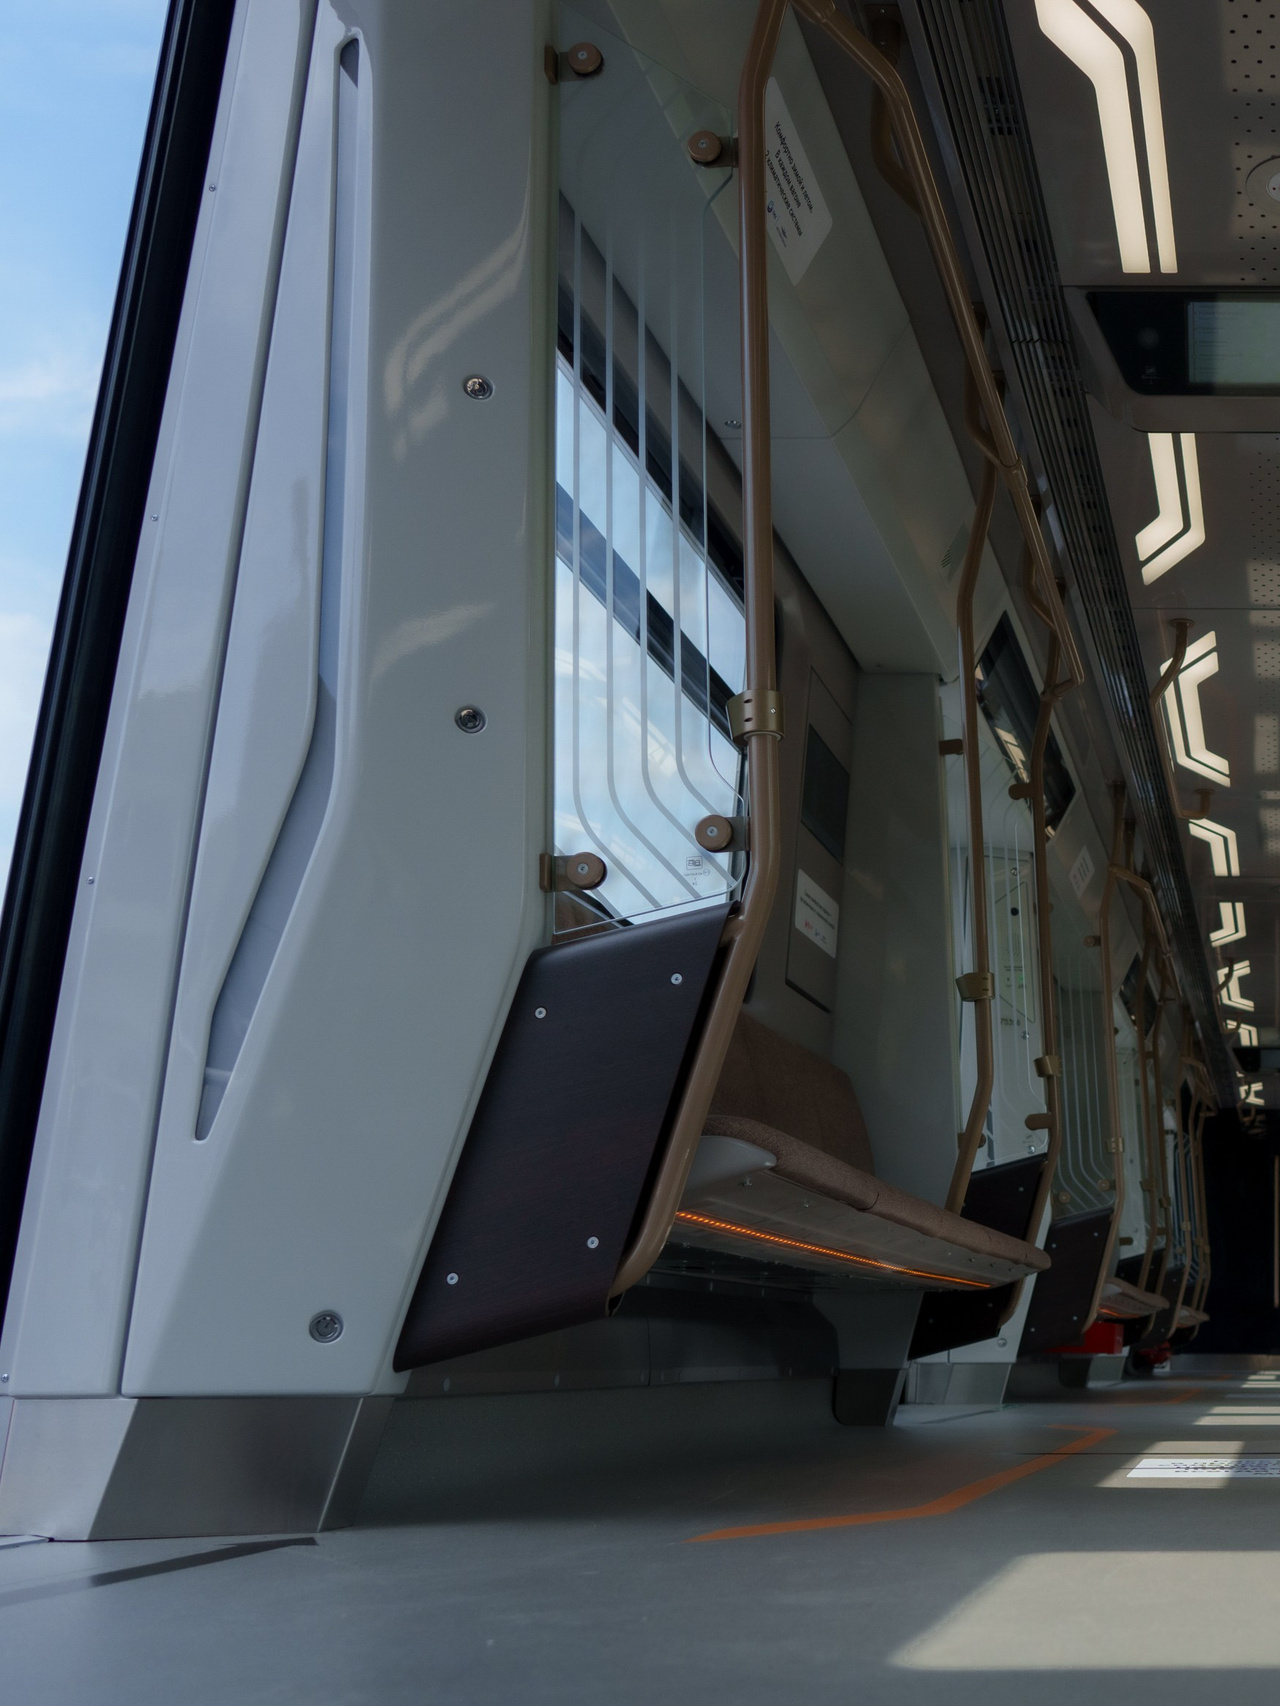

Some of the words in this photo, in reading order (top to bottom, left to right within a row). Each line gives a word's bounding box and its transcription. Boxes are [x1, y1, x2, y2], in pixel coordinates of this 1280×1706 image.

[774, 120, 793, 165] Комфортно
[791, 162, 804, 184] зимой
[777, 156, 792, 187] каждом
[790, 183, 801, 208] вагоне
[767, 157, 790, 210] климатические
[788, 207, 802, 236] системы
